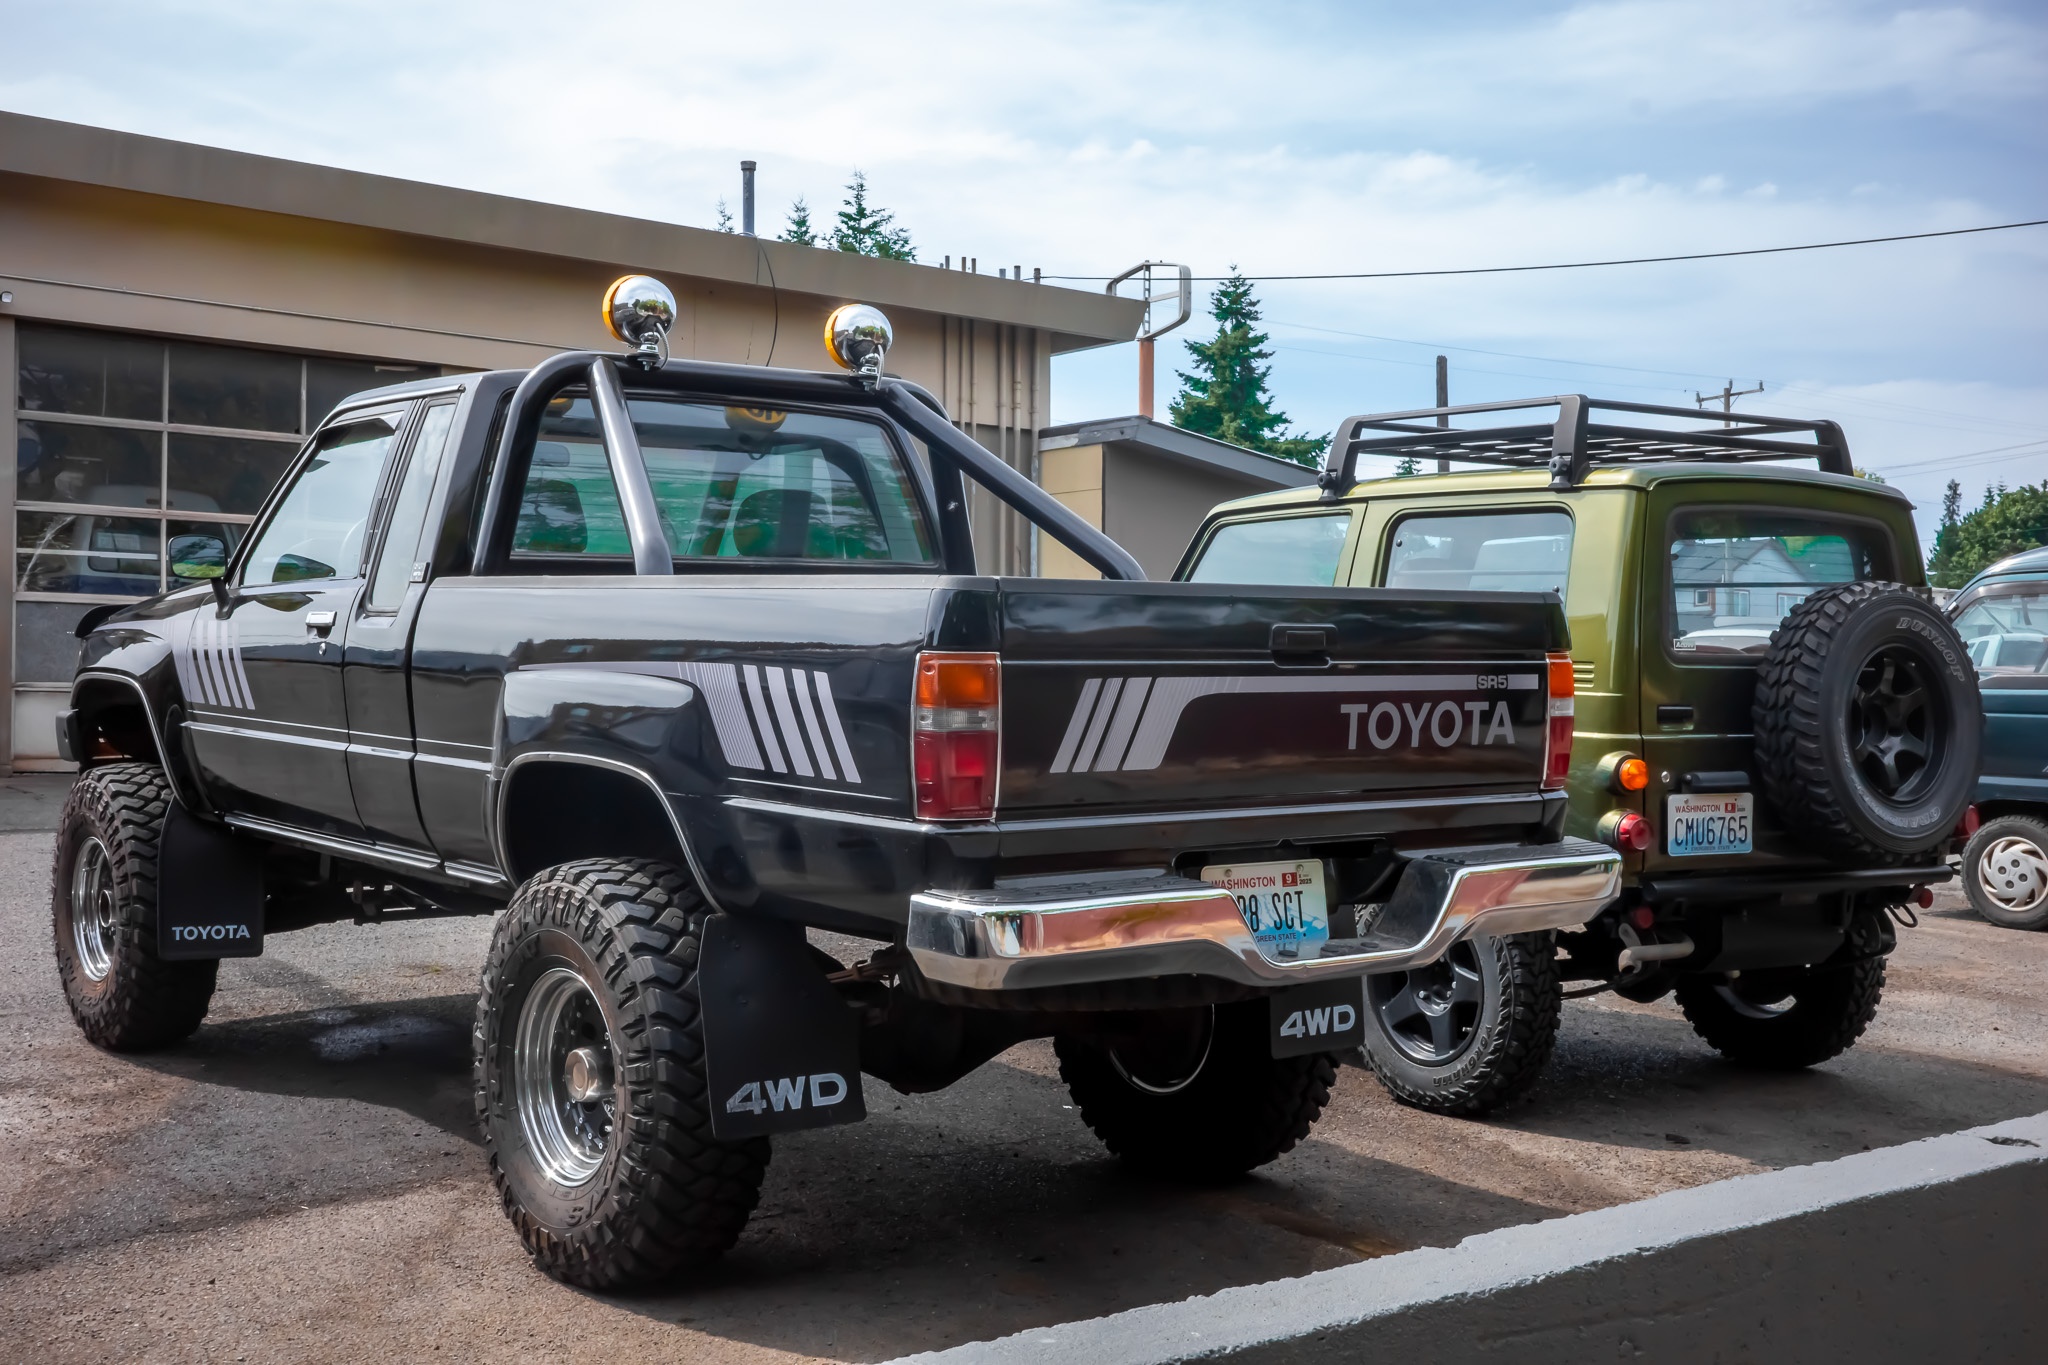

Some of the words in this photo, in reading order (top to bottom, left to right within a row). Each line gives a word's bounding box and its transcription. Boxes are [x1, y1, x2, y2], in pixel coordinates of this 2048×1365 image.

[1896, 617, 1965, 682] DUNLOP
[1477, 675, 1508, 690] SR5
[1340, 700, 1516, 750] TOYOTA
[1675, 804, 1721, 814] WASHINGTON
[1674, 815, 1748, 846] CMU6765
[1211, 876, 1276, 890] WASHINGTON
[1285, 873, 1293, 884] 9
[1272, 890, 1304, 931] SCT
[171, 924, 251, 941] TOYOTA
[1278, 932, 1297, 941] STATE
[1280, 1004, 1356, 1039] 4WD
[726, 1072, 848, 1115] 4WD
